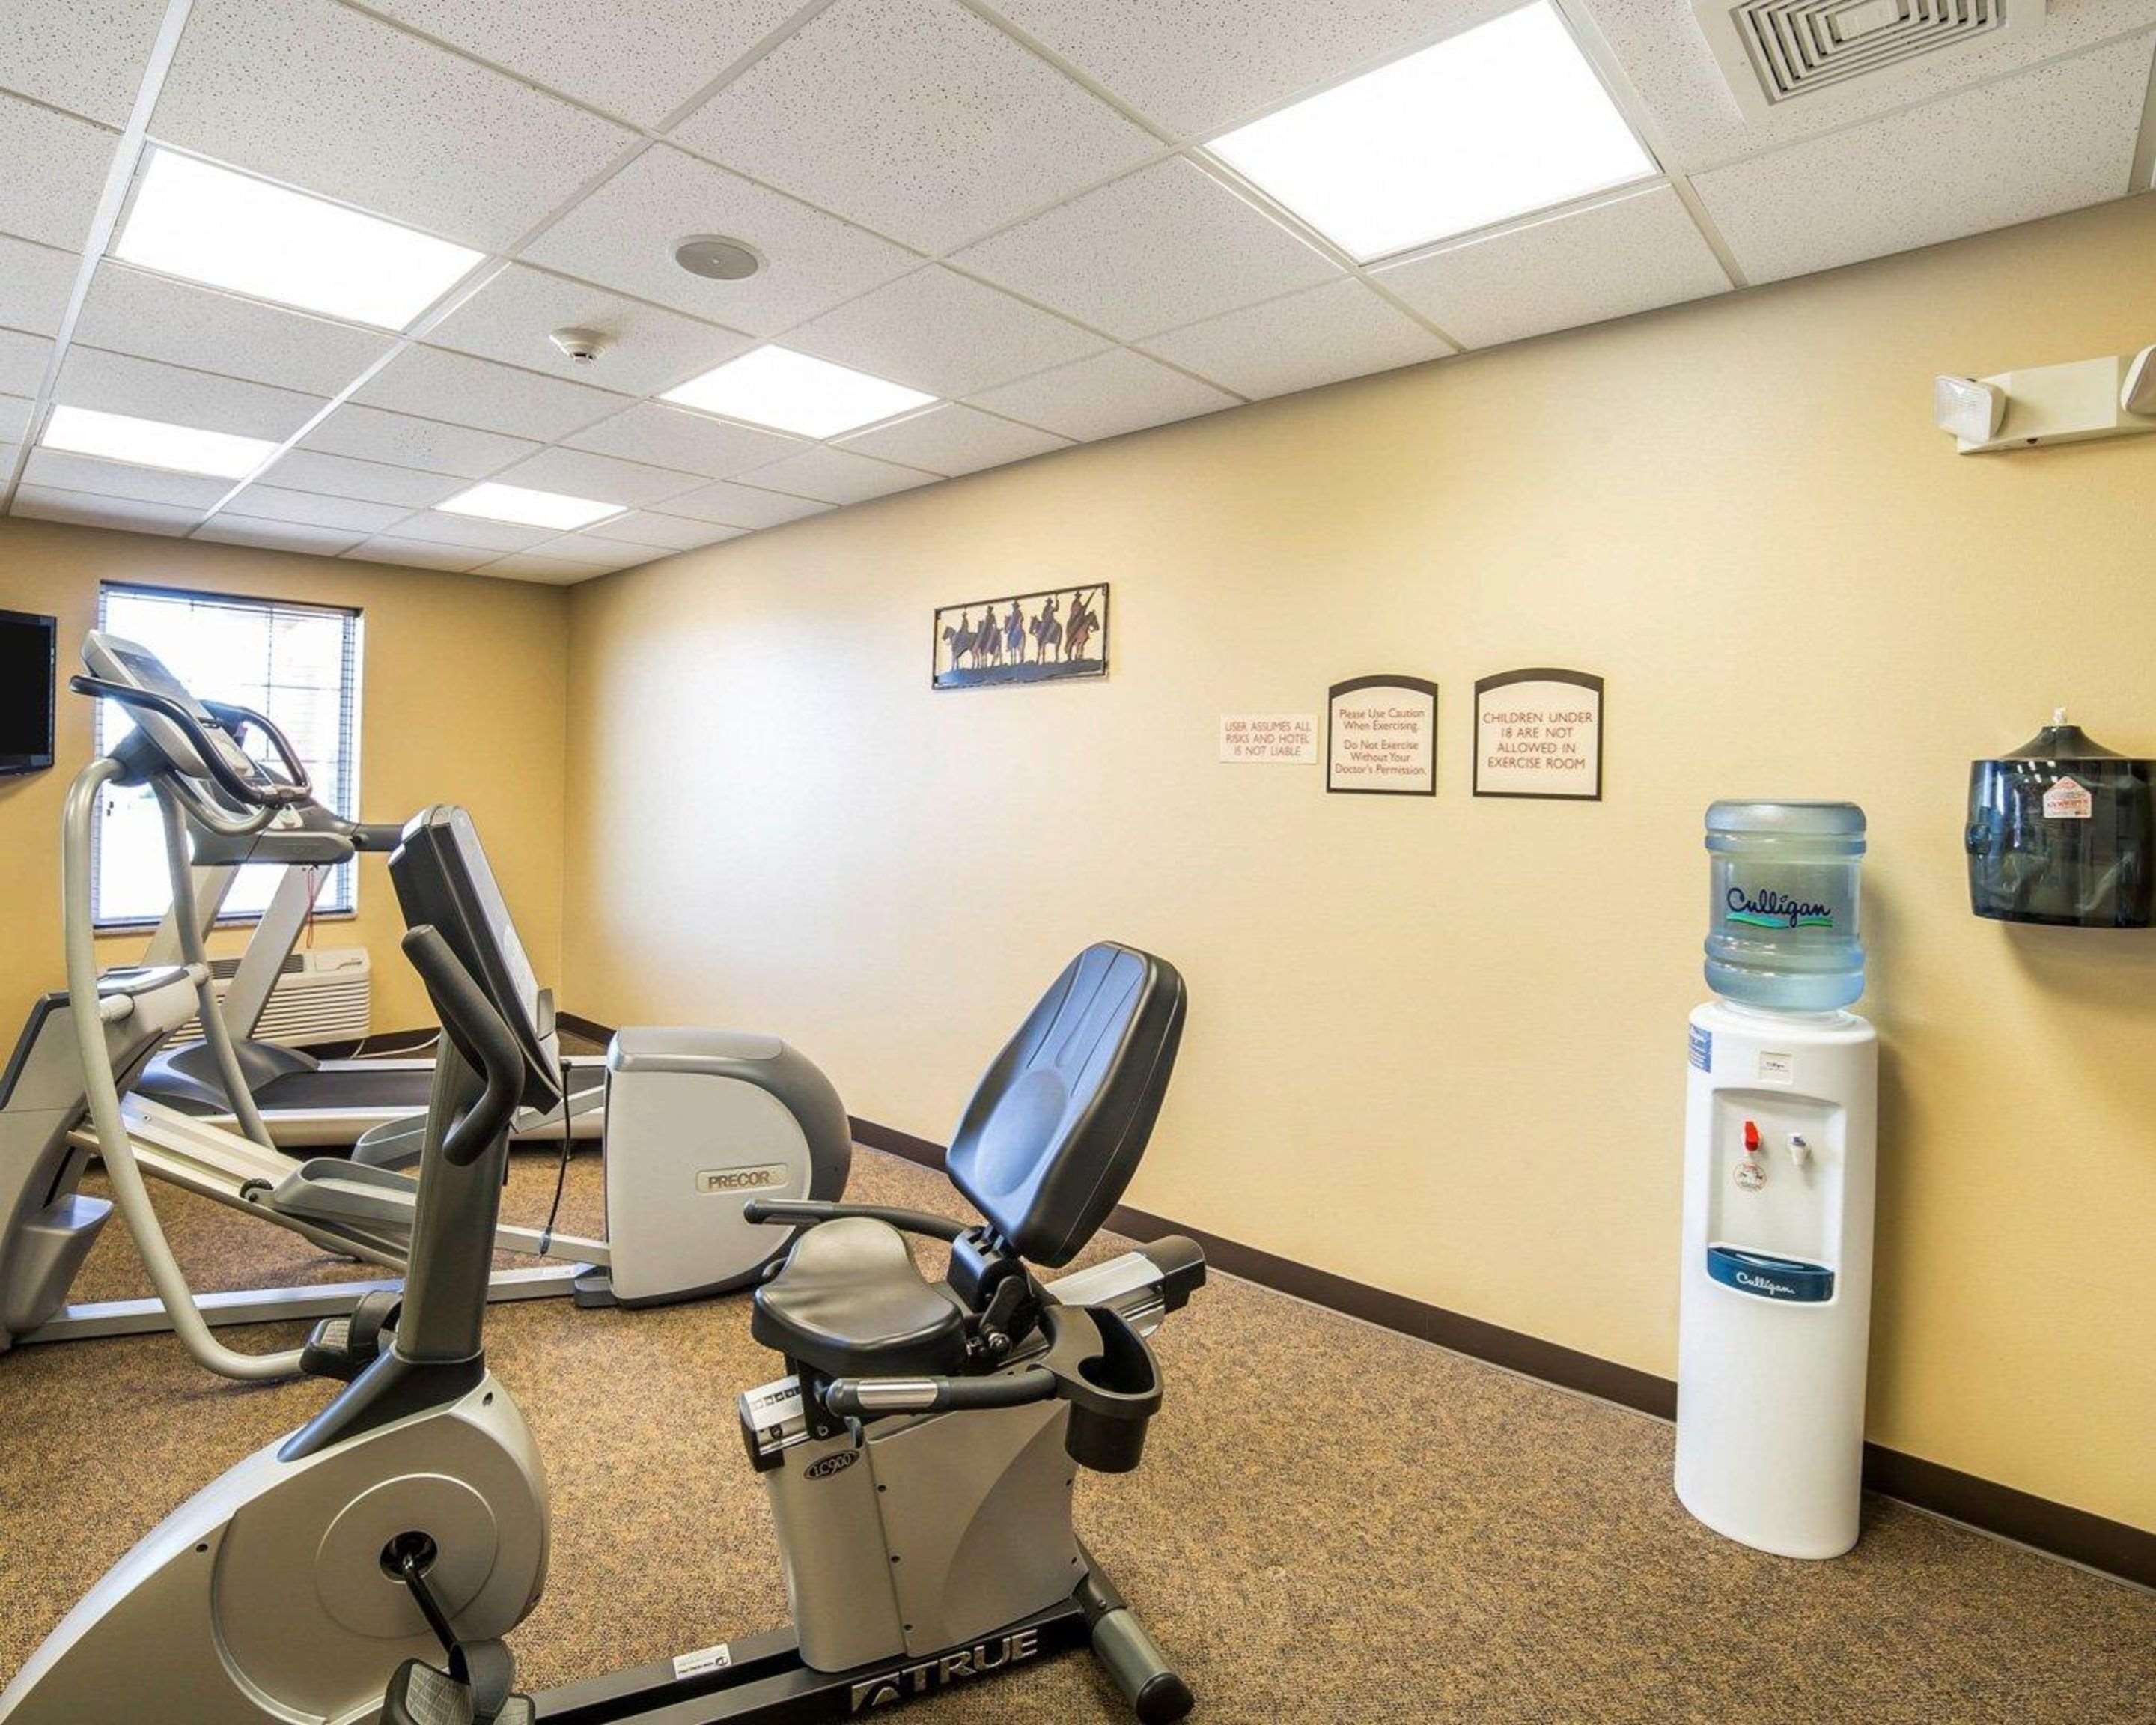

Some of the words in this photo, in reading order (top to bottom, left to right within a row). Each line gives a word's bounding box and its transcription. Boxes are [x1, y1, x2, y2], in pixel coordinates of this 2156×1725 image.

[1339, 709, 1365, 719] Please
[1368, 708, 1386, 718] Use
[1389, 708, 1425, 718] Caution
[1483, 712, 1544, 724] CHILDREN
[1549, 712, 1592, 723] UNDER
[1225, 722, 1247, 732] USER
[1251, 722, 1291, 732] ASSUMES
[1295, 721, 1312, 732] ALL
[1344, 721, 1371, 731] When
[1226, 734, 1250, 743] RISKS
[1253, 734, 1276, 743] AND
[1279, 734, 1310, 743] HOTEL
[1502, 728, 1513, 738] 18
[1517, 728, 1539, 738] ARE
[1546, 728, 1574, 738] NOT
[1344, 739, 1358, 749] Do
[1361, 740, 1379, 749] Not
[1381, 739, 1419, 750] Exercise
[1497, 743, 1557, 754] ALLOWED
[1562, 743, 1577, 754] IN
[1234, 746, 1243, 756] IS
[1246, 746, 1267, 756] NOT
[1270, 746, 1301, 756] LIABLE
[1350, 752, 1388, 762] Without
[1389, 752, 1411, 762] Your
[1335, 763, 1374, 773] Doctor's
[1487, 757, 1541, 769] EXERCISE
[1546, 758, 1586, 770] ROOM
[1727, 887, 1831, 928] Culligan
[708, 1170, 770, 1189] PRECOR
[1736, 1271, 1796, 1295] Culligan
[901, 1628, 1038, 1693] TRUE
